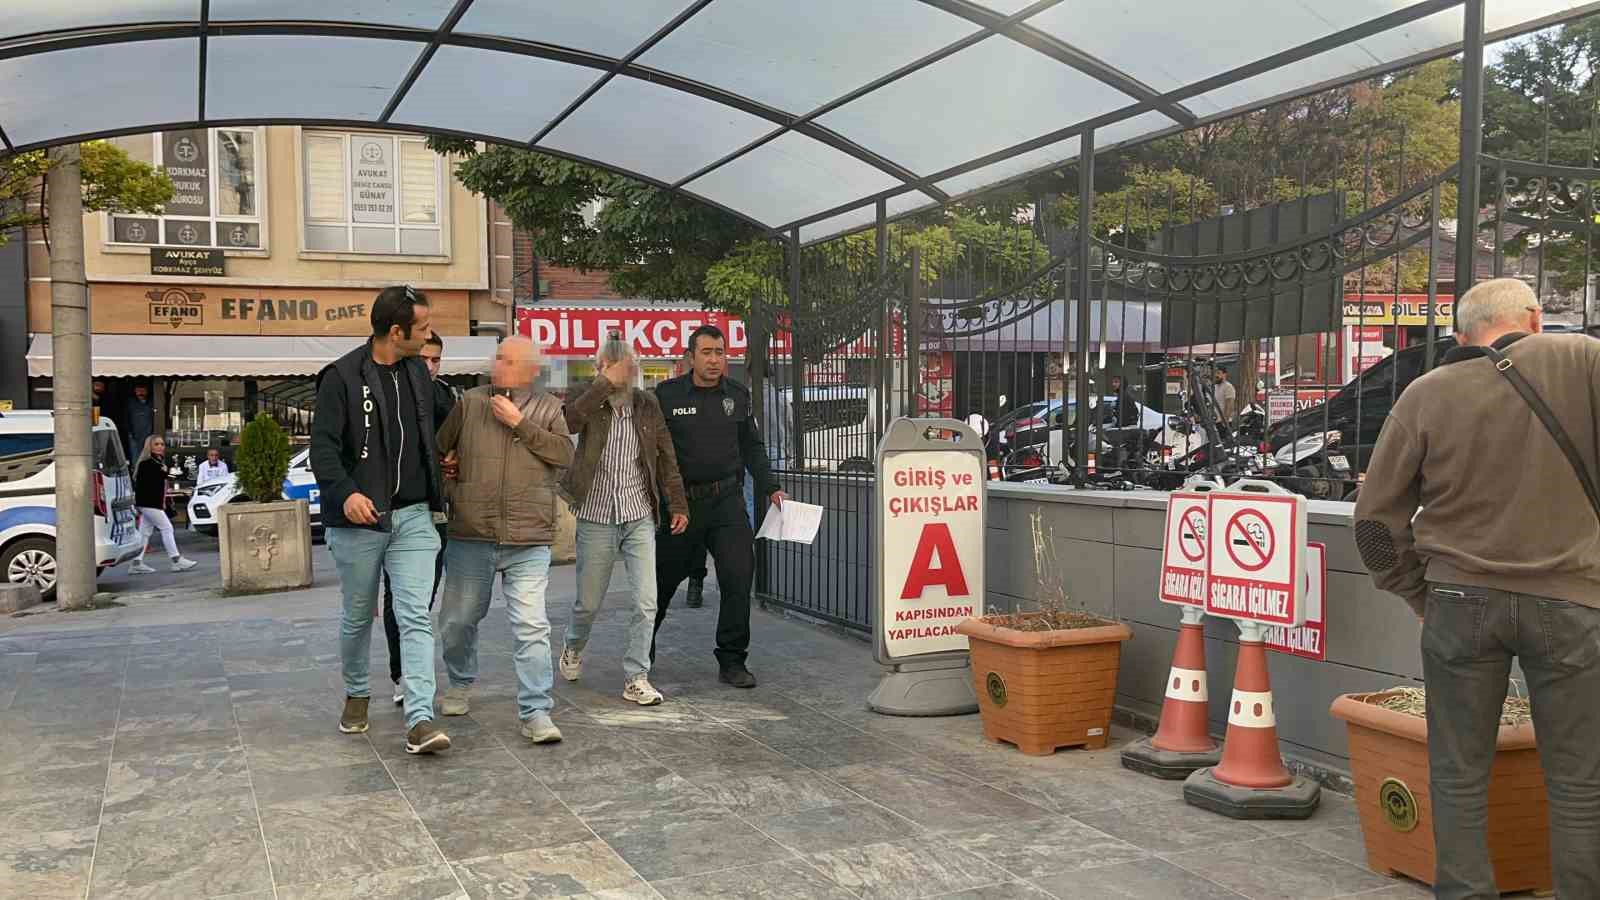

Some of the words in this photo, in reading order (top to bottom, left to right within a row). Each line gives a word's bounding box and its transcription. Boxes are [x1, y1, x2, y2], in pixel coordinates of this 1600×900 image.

[167, 167, 207, 177] KORKMAZ
[165, 251, 210, 260] AVUKAT
[154, 306, 198, 317] EFANO
[221, 298, 318, 321] EFANO
[325, 303, 366, 321] CAFE
[1392, 303, 1456, 319] DİLEKÇ
[530, 312, 701, 355] DİLEKÇE
[894, 466, 946, 490] GİRİŞ
[952, 473, 972, 485] ve
[889, 495, 978, 517] ÇIKIŞLAR
[900, 522, 970, 600] A
[1164, 568, 1190, 600] SİGARA
[1188, 571, 1204, 603] İÇİL
[1211, 579, 1247, 613] SİGARA
[1248, 582, 1289, 617] İÇİLMEZ
[896, 606, 973, 622] KAPISINDAN
[888, 624, 961, 641] YAPILACAK
